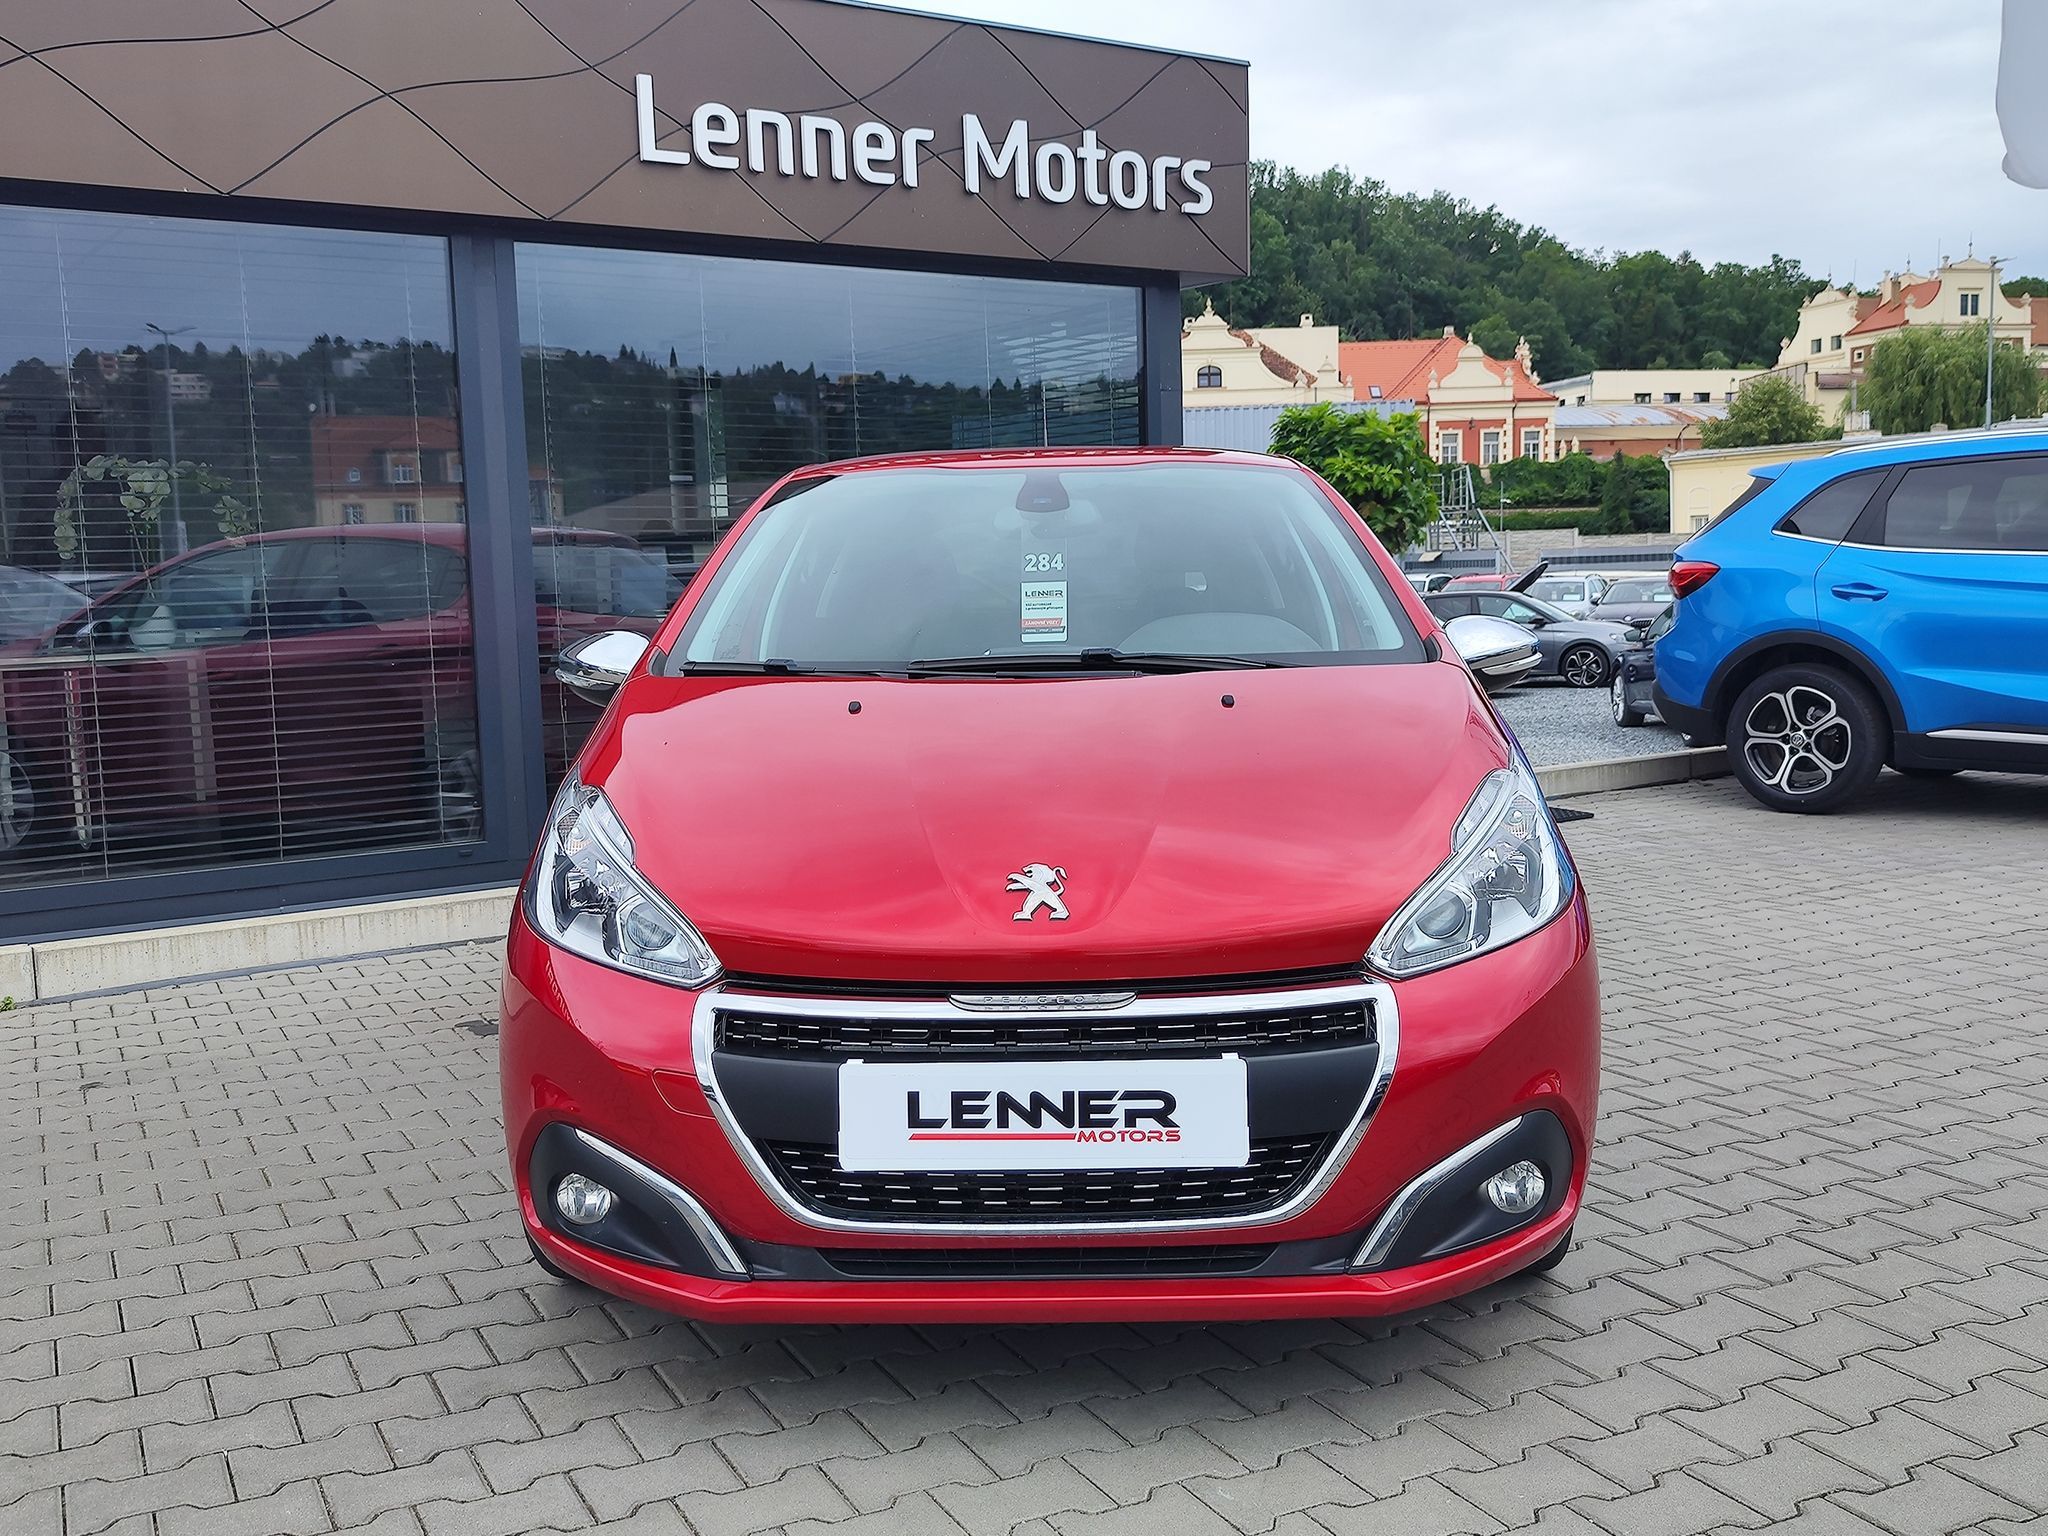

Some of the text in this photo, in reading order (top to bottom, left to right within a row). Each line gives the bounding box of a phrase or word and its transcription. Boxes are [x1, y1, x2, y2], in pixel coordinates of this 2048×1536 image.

[635, 74, 1214, 214] Lenner Motors
[1024, 553, 1064, 572] 284
[907, 1090, 1181, 1129] LENNER
[1076, 1129, 1182, 1143] MOTORS
